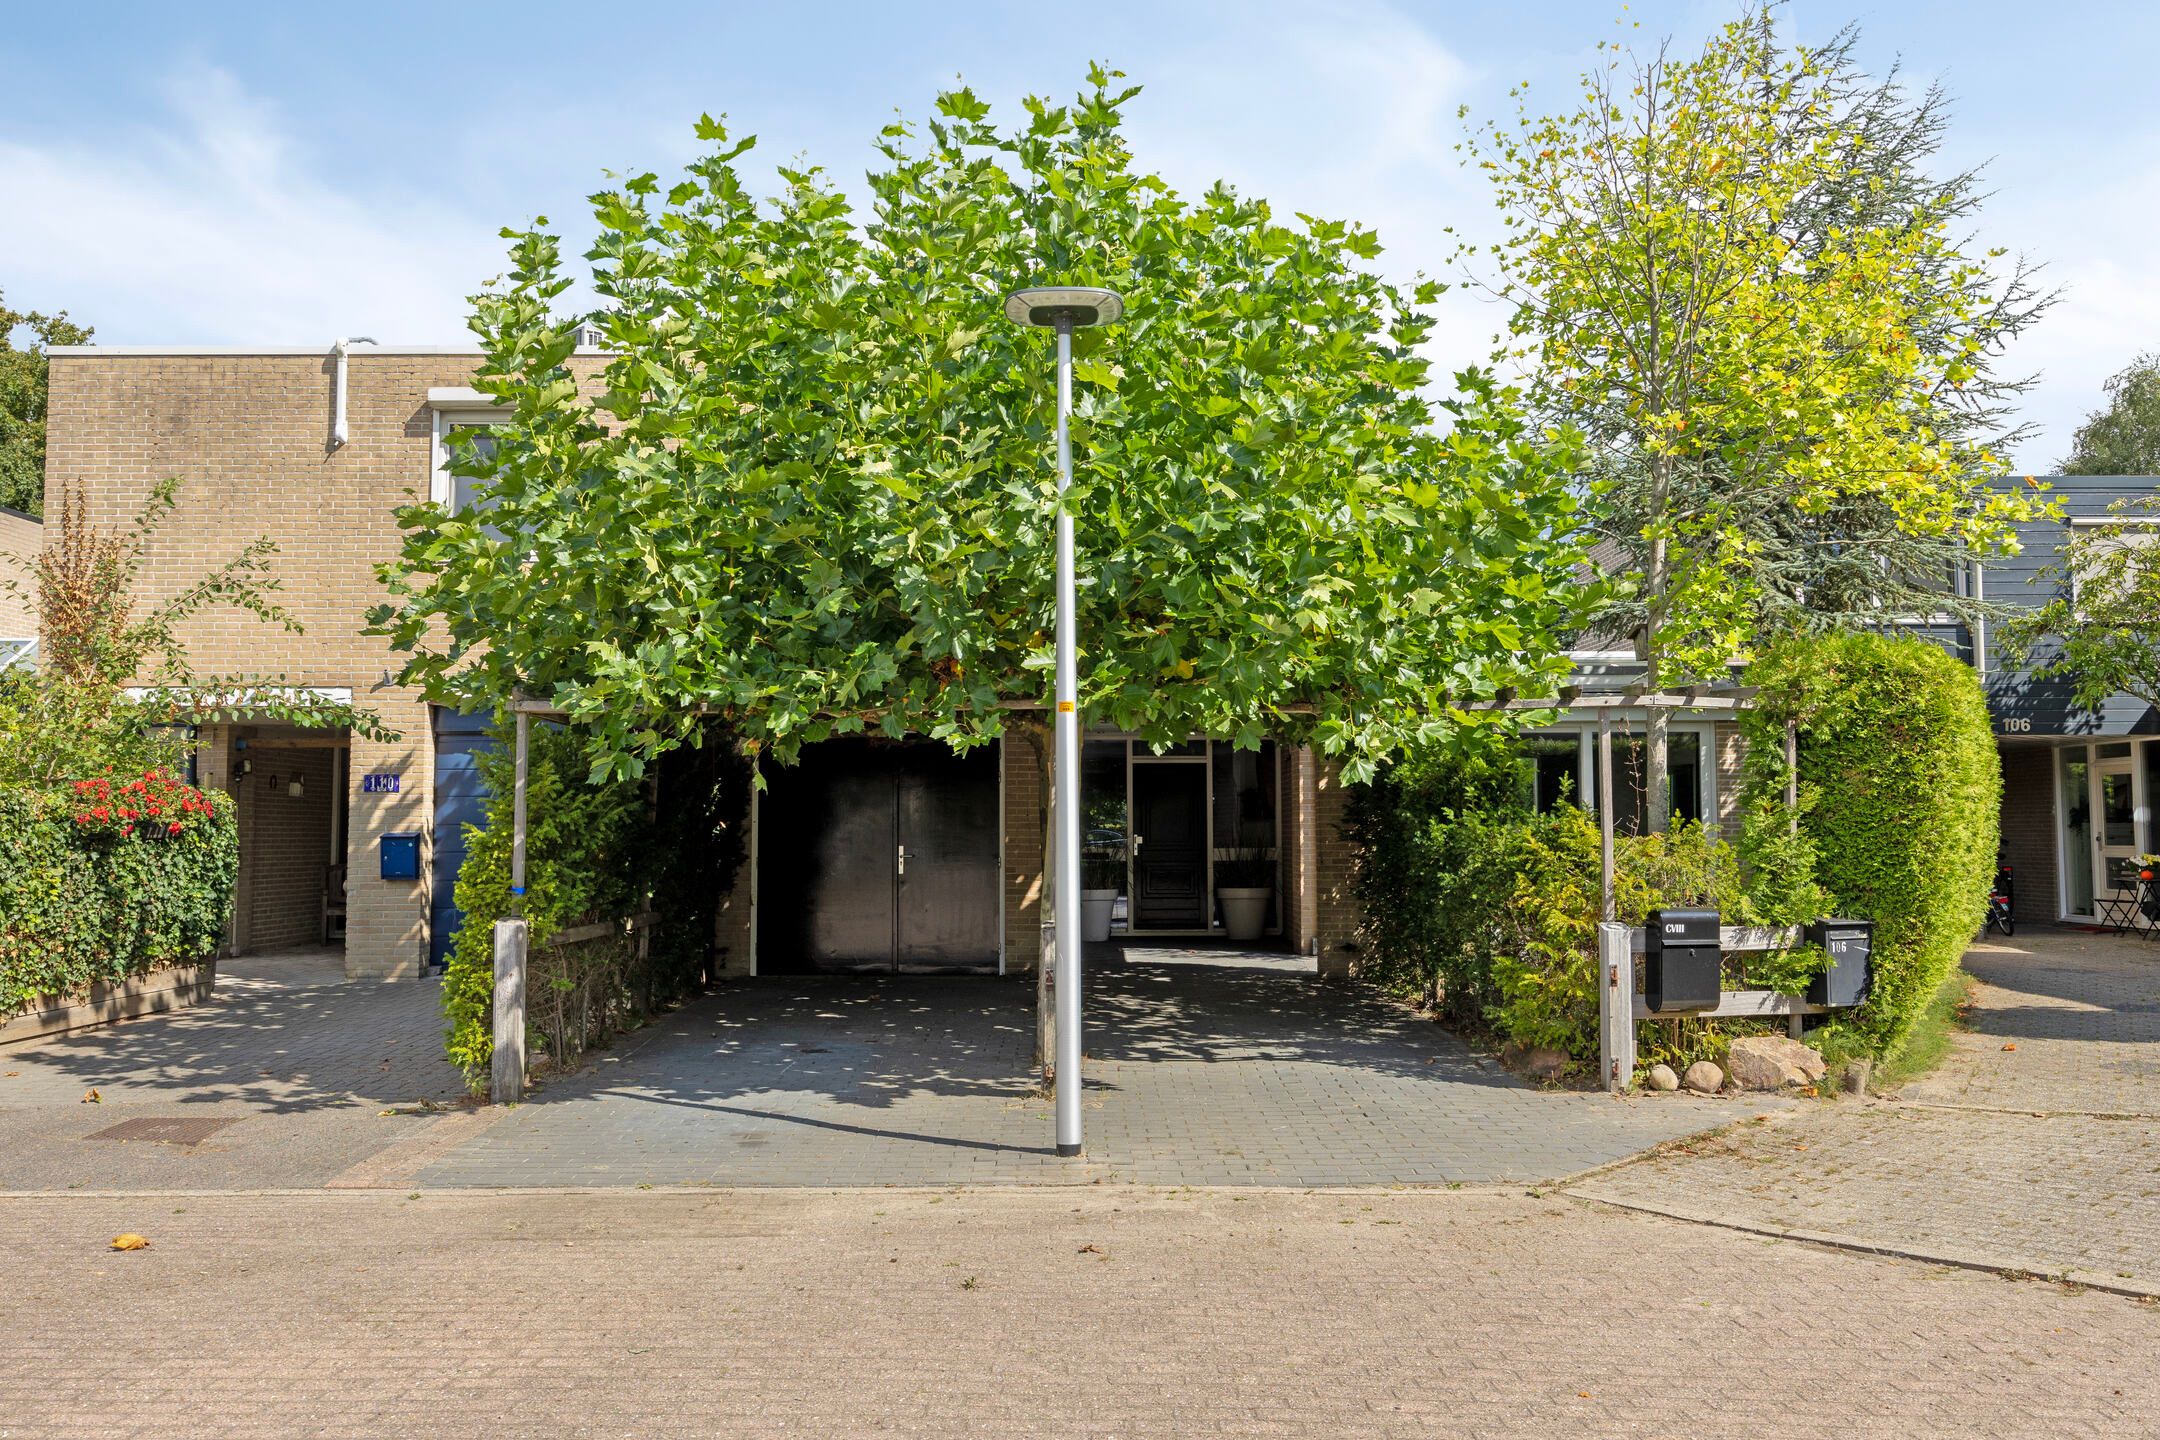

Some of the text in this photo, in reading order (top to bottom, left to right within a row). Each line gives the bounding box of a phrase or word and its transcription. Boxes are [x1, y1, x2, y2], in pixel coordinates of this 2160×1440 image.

[2003, 718, 2031, 732] 106
[1665, 923, 1685, 933] CVIII
[1831, 941, 1847, 953] 106
